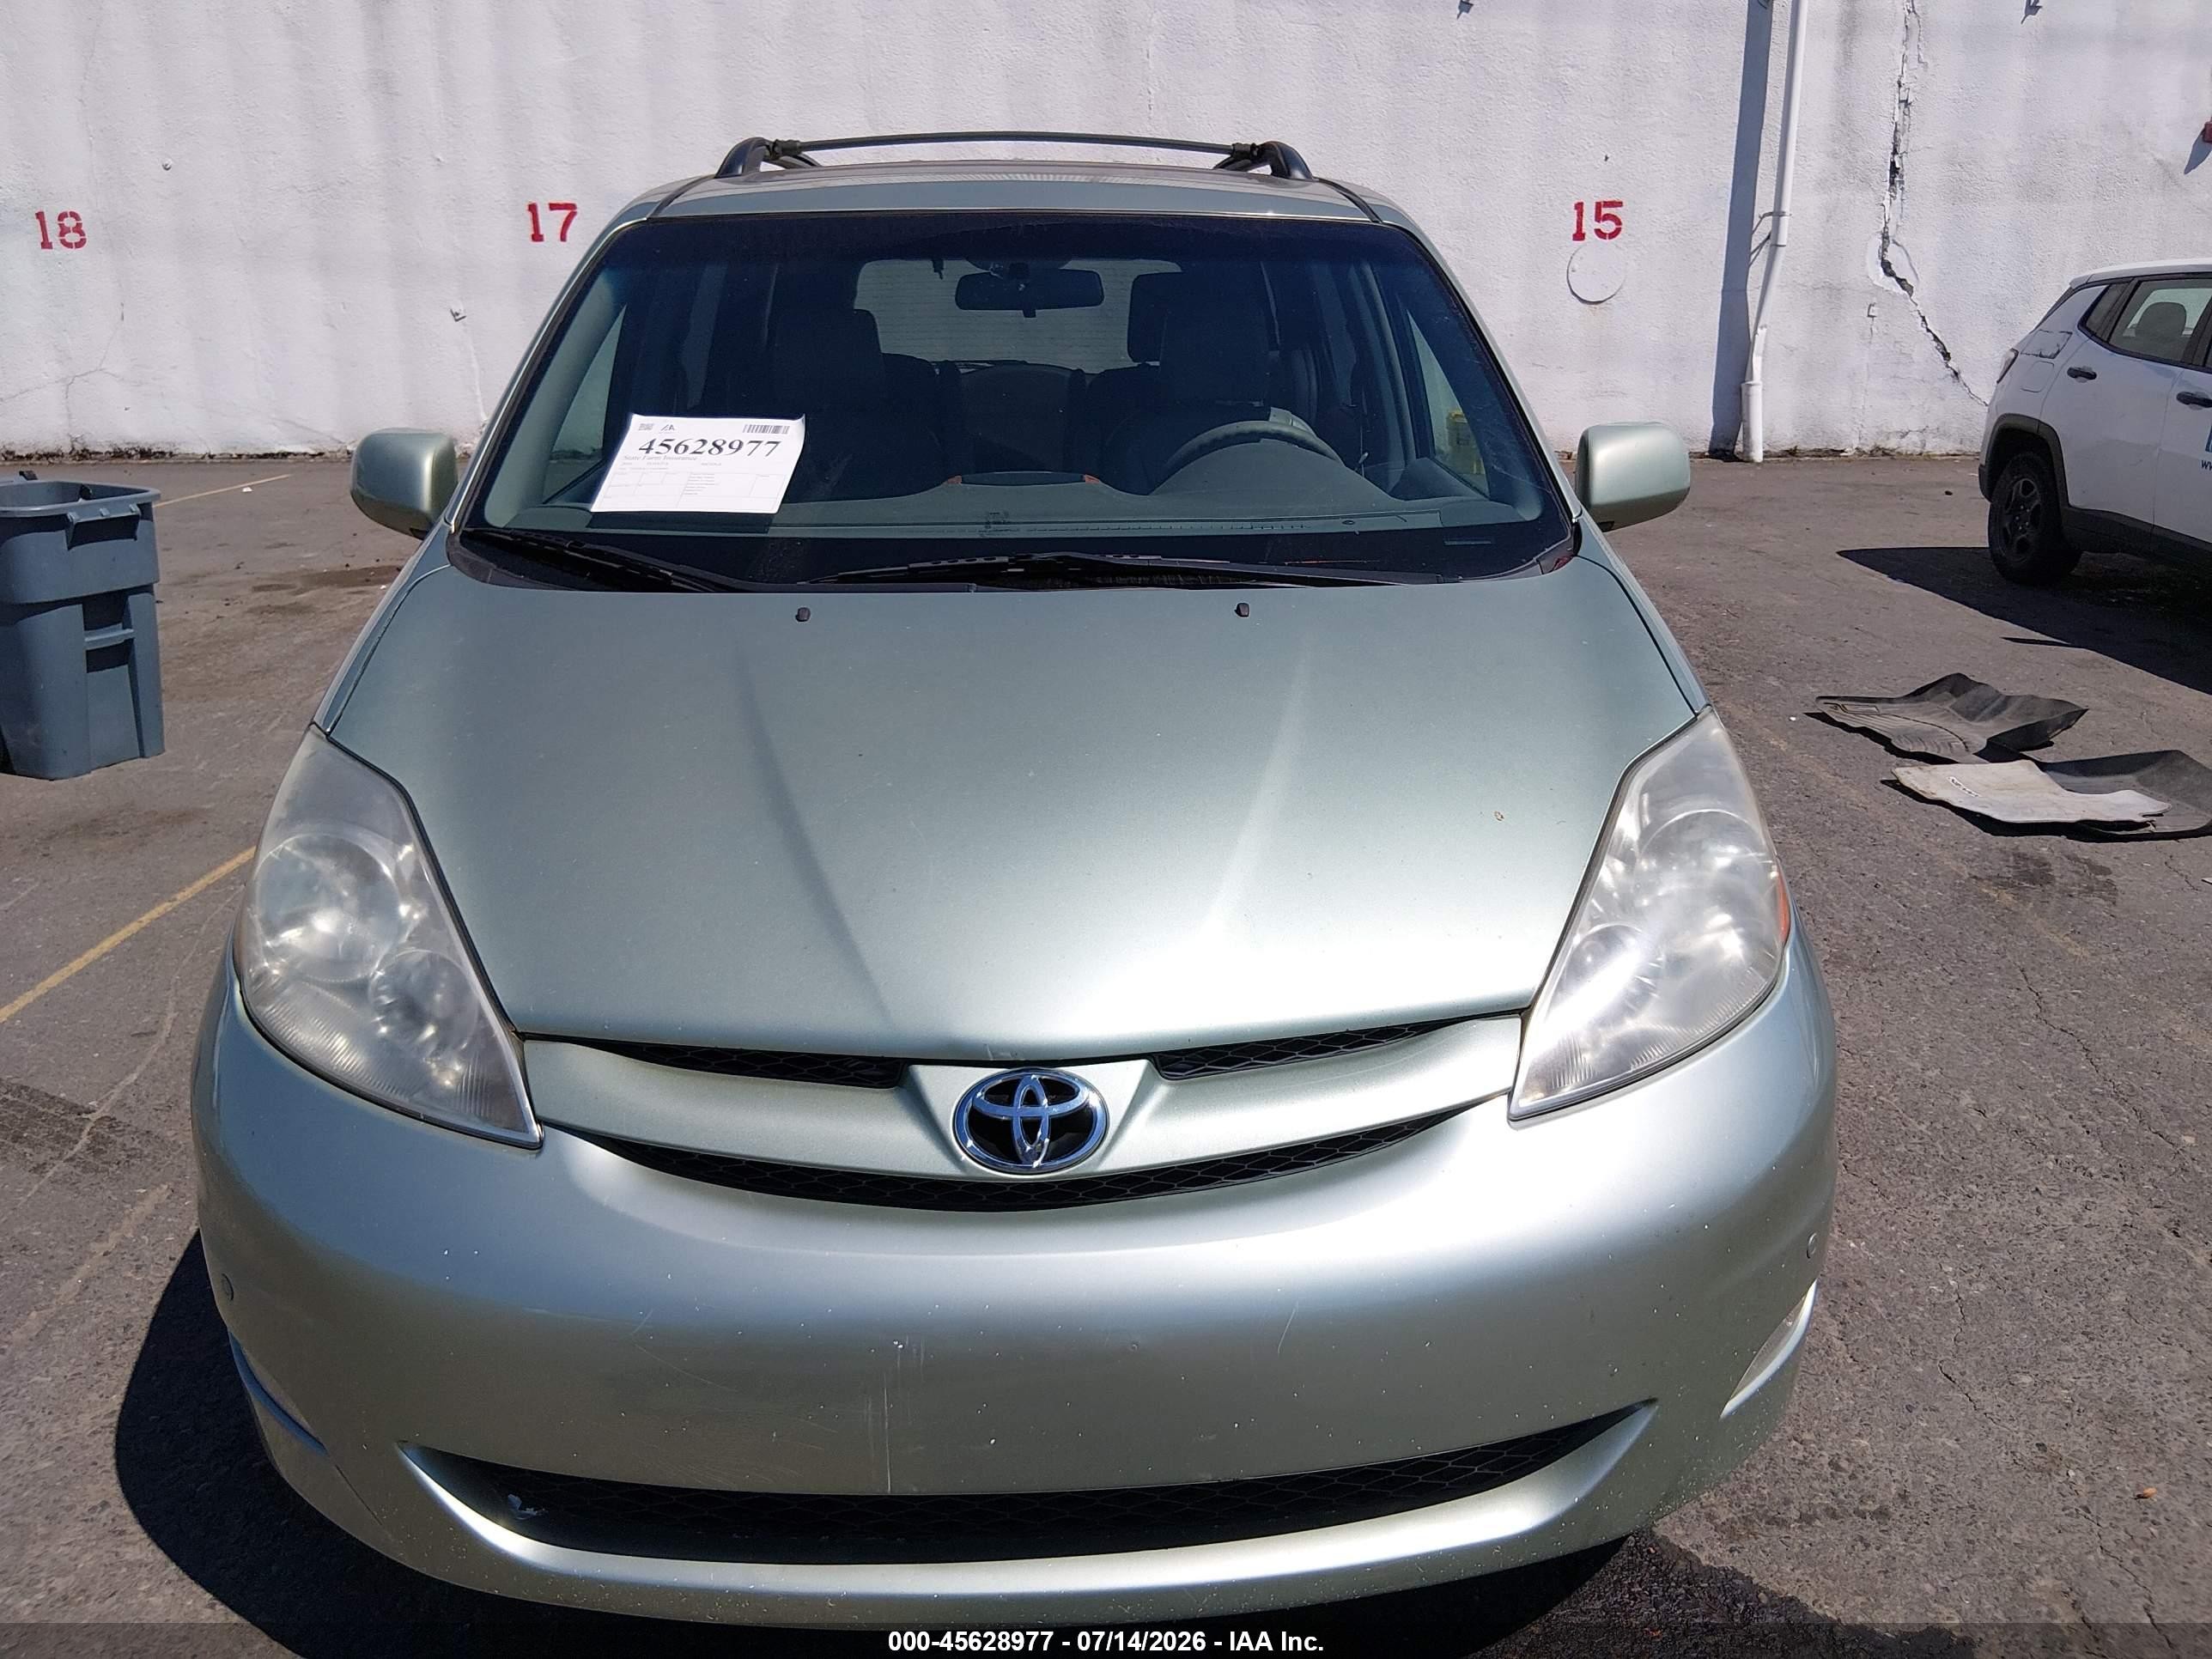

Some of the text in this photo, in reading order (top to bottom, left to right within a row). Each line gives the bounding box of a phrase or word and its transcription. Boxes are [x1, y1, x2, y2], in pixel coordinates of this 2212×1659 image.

[35, 211, 88, 251] 18
[527, 202, 579, 245] 17
[1572, 200, 1624, 244] 15
[638, 438, 782, 457] 45628977
